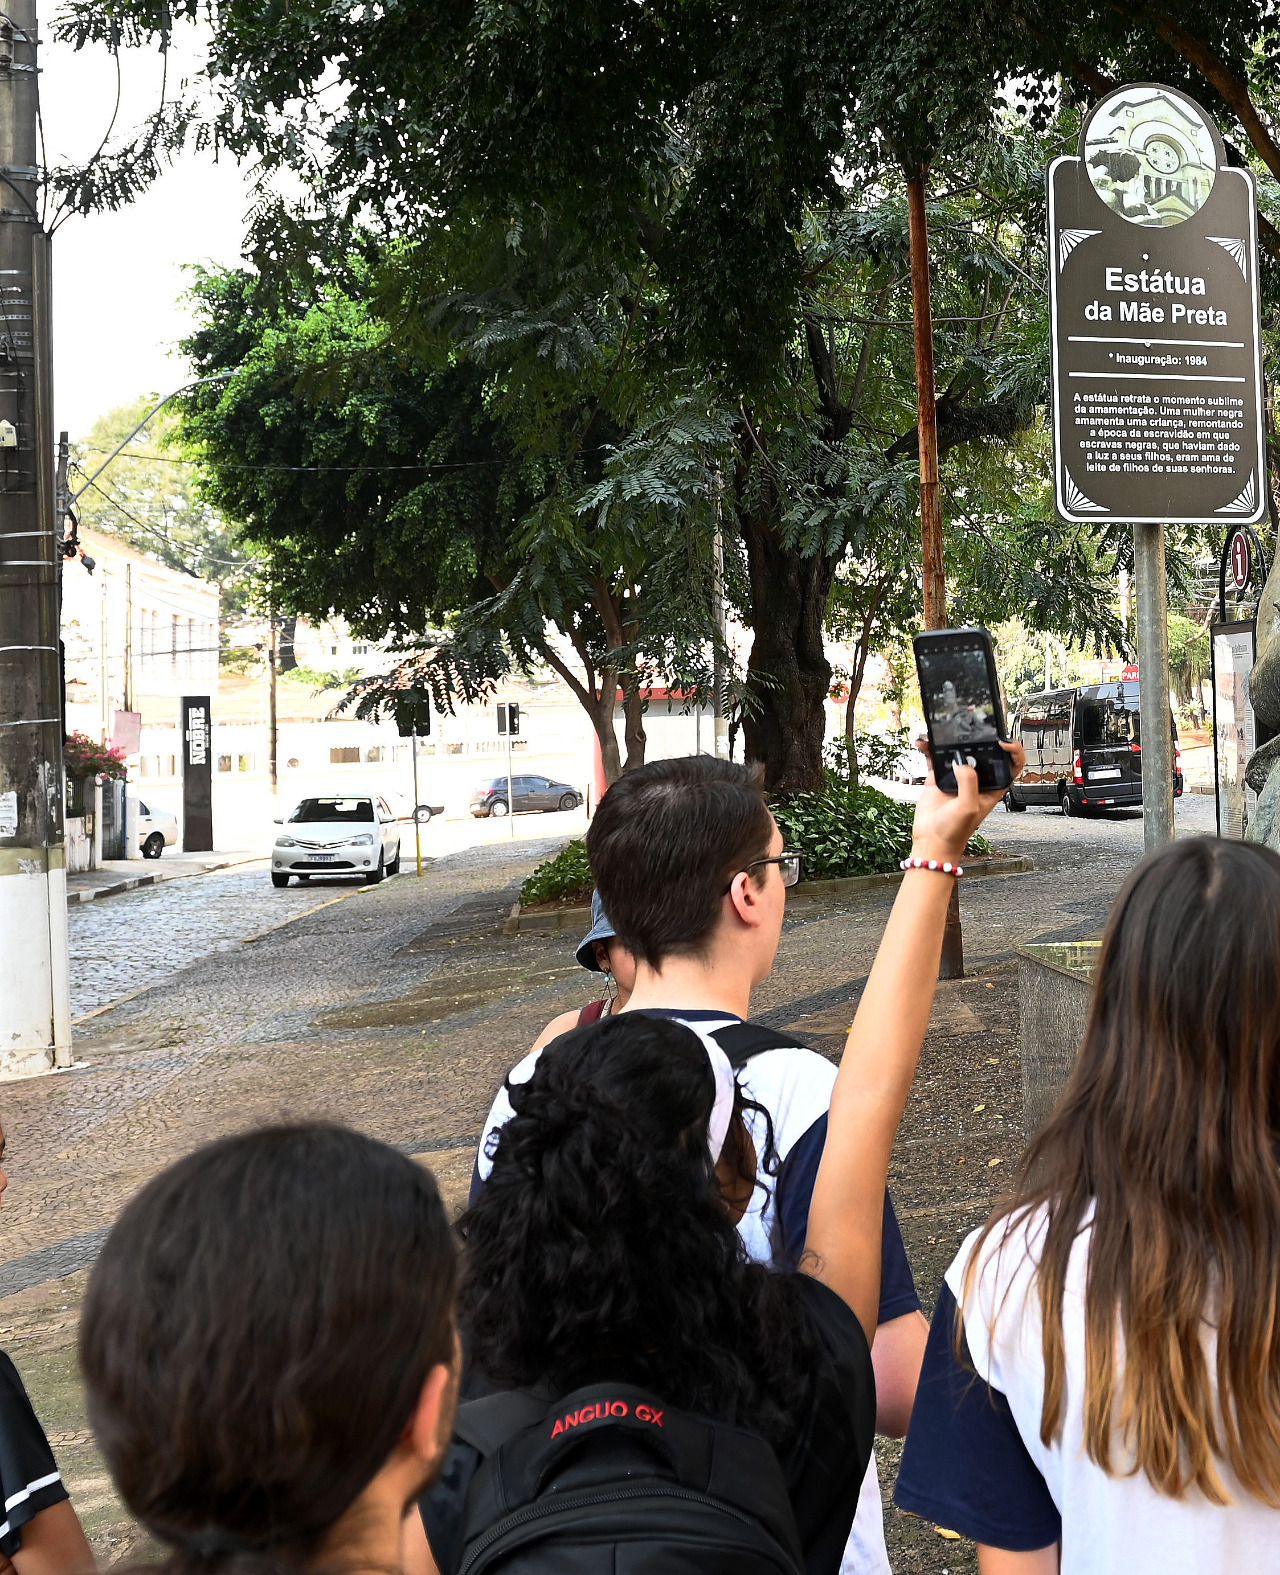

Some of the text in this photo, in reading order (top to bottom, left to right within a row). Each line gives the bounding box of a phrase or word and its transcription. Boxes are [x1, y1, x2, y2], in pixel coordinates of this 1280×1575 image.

[1105, 267, 1206, 295] Estátua
[1085, 300, 1227, 326] da Mãe Preta
[1116, 353, 1208, 367] Inauguração: 1984
[1073, 392, 1081, 402] A
[1083, 393, 1118, 402] estátua
[1120, 394, 1151, 403] retrata
[1162, 396, 1205, 404] momento
[1208, 397, 1244, 406] sublime
[1074, 404, 1243, 419] da amamentação. Uma mulher negra
[1075, 417, 1243, 428] amamenta uma criança, remontando
[1098, 428, 1127, 439] época
[1130, 429, 1141, 437] da
[1144, 429, 1194, 438] escravidão
[1196, 431, 1210, 439] em
[1213, 432, 1230, 441] que
[1125, 442, 1159, 451] negras,
[1162, 443, 1180, 451] que
[1182, 441, 1215, 450] haviam
[1218, 442, 1240, 451] dado
[1087, 452, 1092, 460] a
[1095, 451, 1109, 460] luz
[1145, 452, 1174, 462] filhos,
[1176, 454, 1199, 462] eram
[1202, 454, 1220, 462] ama
[1223, 453, 1234, 462] de
[1086, 462, 1106, 472] leite
[1109, 463, 1120, 472] de
[1123, 463, 1149, 472] filhos
[1152, 463, 1163, 472] de
[1190, 464, 1236, 474] senhoras.
[1123, 672, 1139, 680] PAR
[191, 707, 206, 765] NOBRE
[635, 1404, 664, 1428] GX
